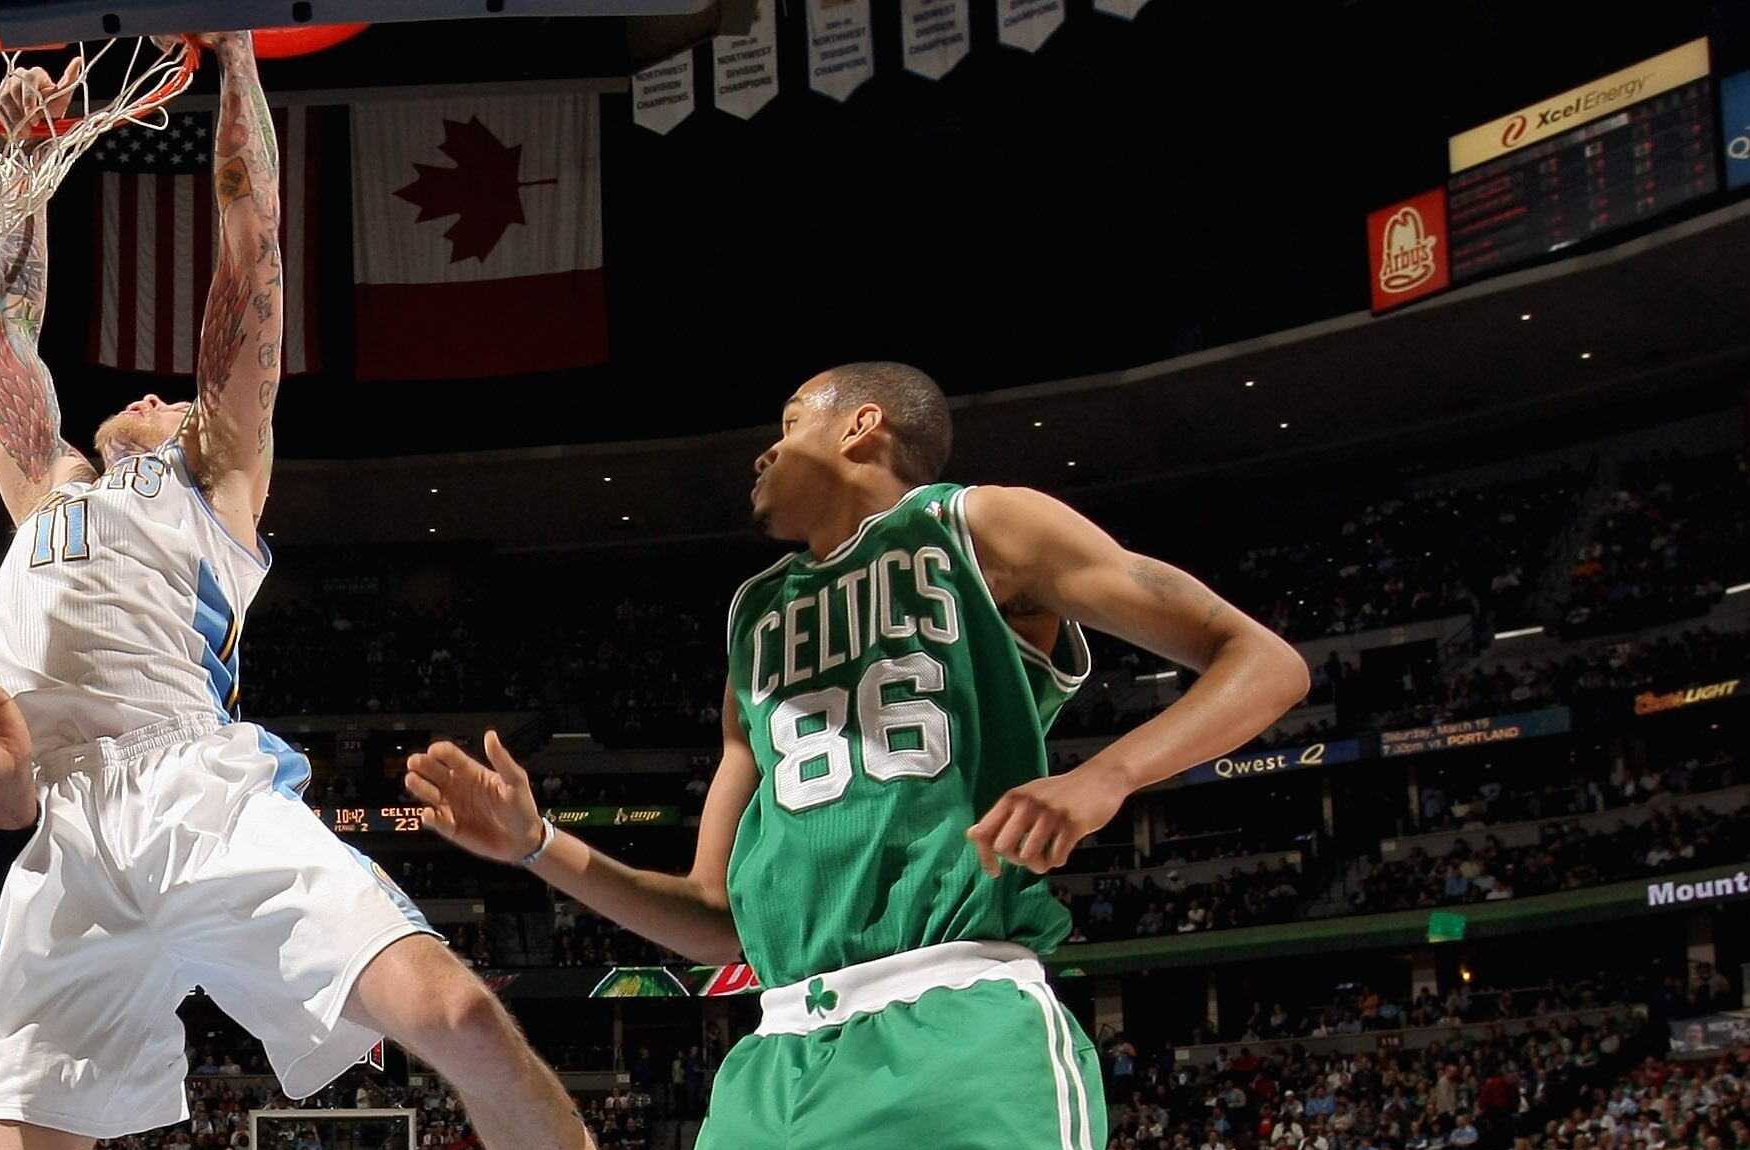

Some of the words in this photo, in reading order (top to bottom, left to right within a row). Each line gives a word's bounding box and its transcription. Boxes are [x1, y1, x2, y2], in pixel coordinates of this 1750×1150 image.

[717, 46, 772, 65] NORTHWEST
[29, 499, 90, 568] 11
[751, 545, 960, 706] CELTICS
[1684, 678, 1741, 704] LIGHT
[768, 650, 954, 817] 86
[1446, 726, 1521, 747] PORTLAND
[1214, 754, 1289, 779] Qwest
[335, 808, 365, 824] 10:47
[381, 807, 424, 817] CELTIC
[360, 823, 368, 832] 2
[394, 817, 421, 831] 23
[1647, 870, 1750, 907] Mount
